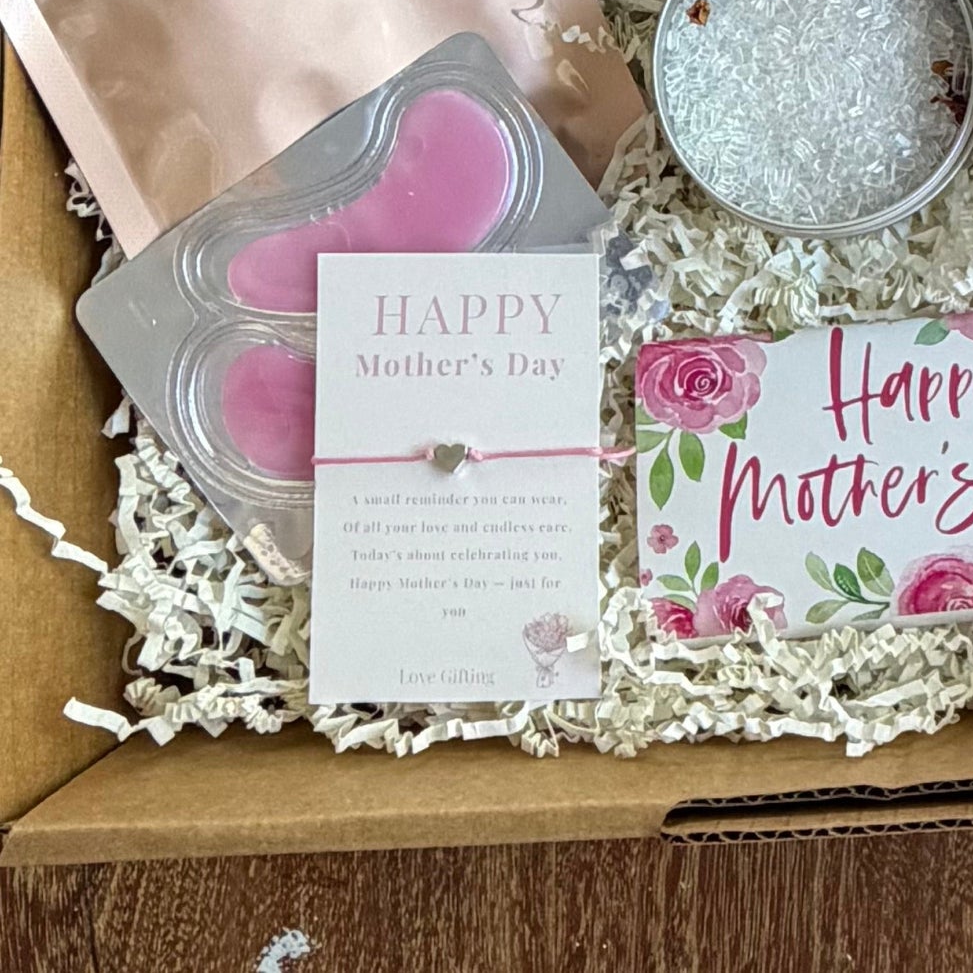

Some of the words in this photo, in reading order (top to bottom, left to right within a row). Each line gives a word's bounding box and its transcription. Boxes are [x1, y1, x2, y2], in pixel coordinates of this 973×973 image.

[372, 293, 562, 336] HAPPY
[507, 352, 565, 382] Day
[364, 493, 400, 506] small
[405, 493, 469, 506] reminder
[473, 496, 497, 507] you
[502, 496, 526, 505] can
[343, 521, 360, 534] Of
[363, 521, 381, 533] all
[384, 524, 417, 536] your
[421, 520, 448, 533] love
[453, 520, 478, 533] and
[482, 520, 535, 533] endless
[407, 548, 446, 561] about
[450, 547, 529, 562] celebrating
[350, 578, 392, 591] Happy
[463, 578, 488, 591] Day
[510, 577, 536, 590] just
[541, 577, 561, 589] for
[442, 607, 467, 619] you
[400, 669, 437, 684] Love
[440, 668, 495, 685] Gifting
